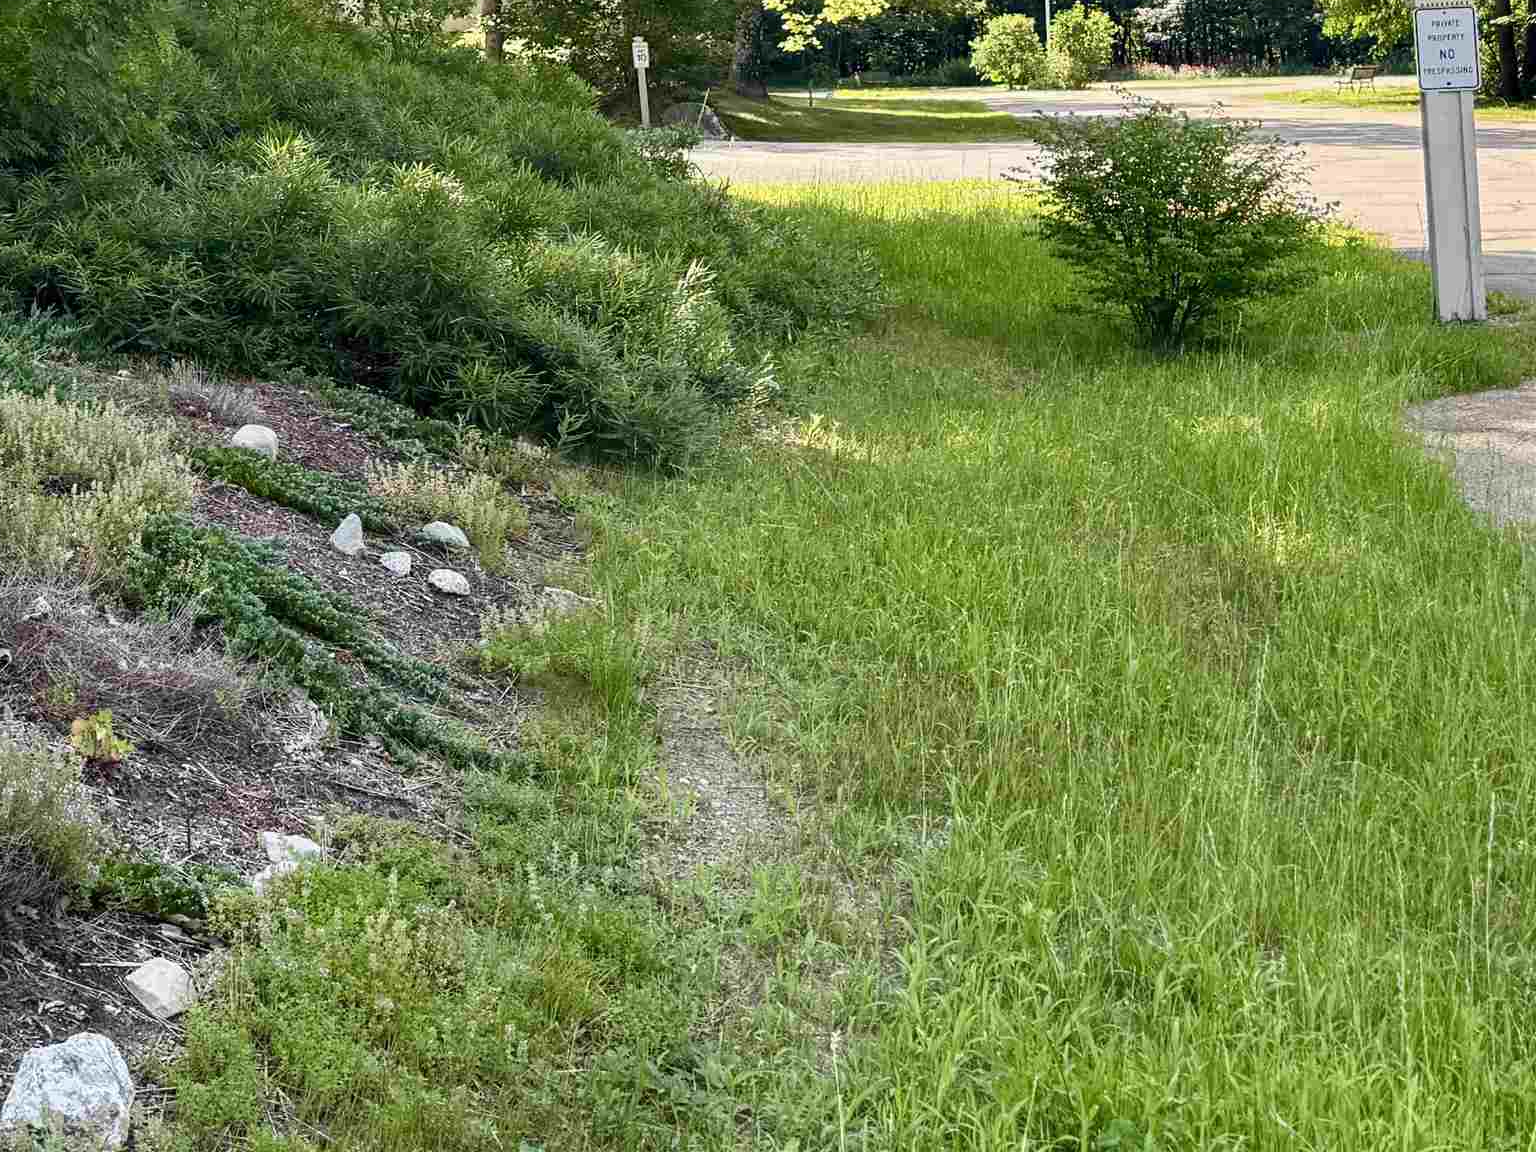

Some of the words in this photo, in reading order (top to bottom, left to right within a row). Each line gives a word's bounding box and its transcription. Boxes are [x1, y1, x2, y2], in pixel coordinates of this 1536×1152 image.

[1431, 19, 1460, 27] PRIVATE
[1427, 33, 1464, 41] PROPERTY
[1439, 48, 1455, 60] NO
[1424, 65, 1473, 74] TRESPASSING
